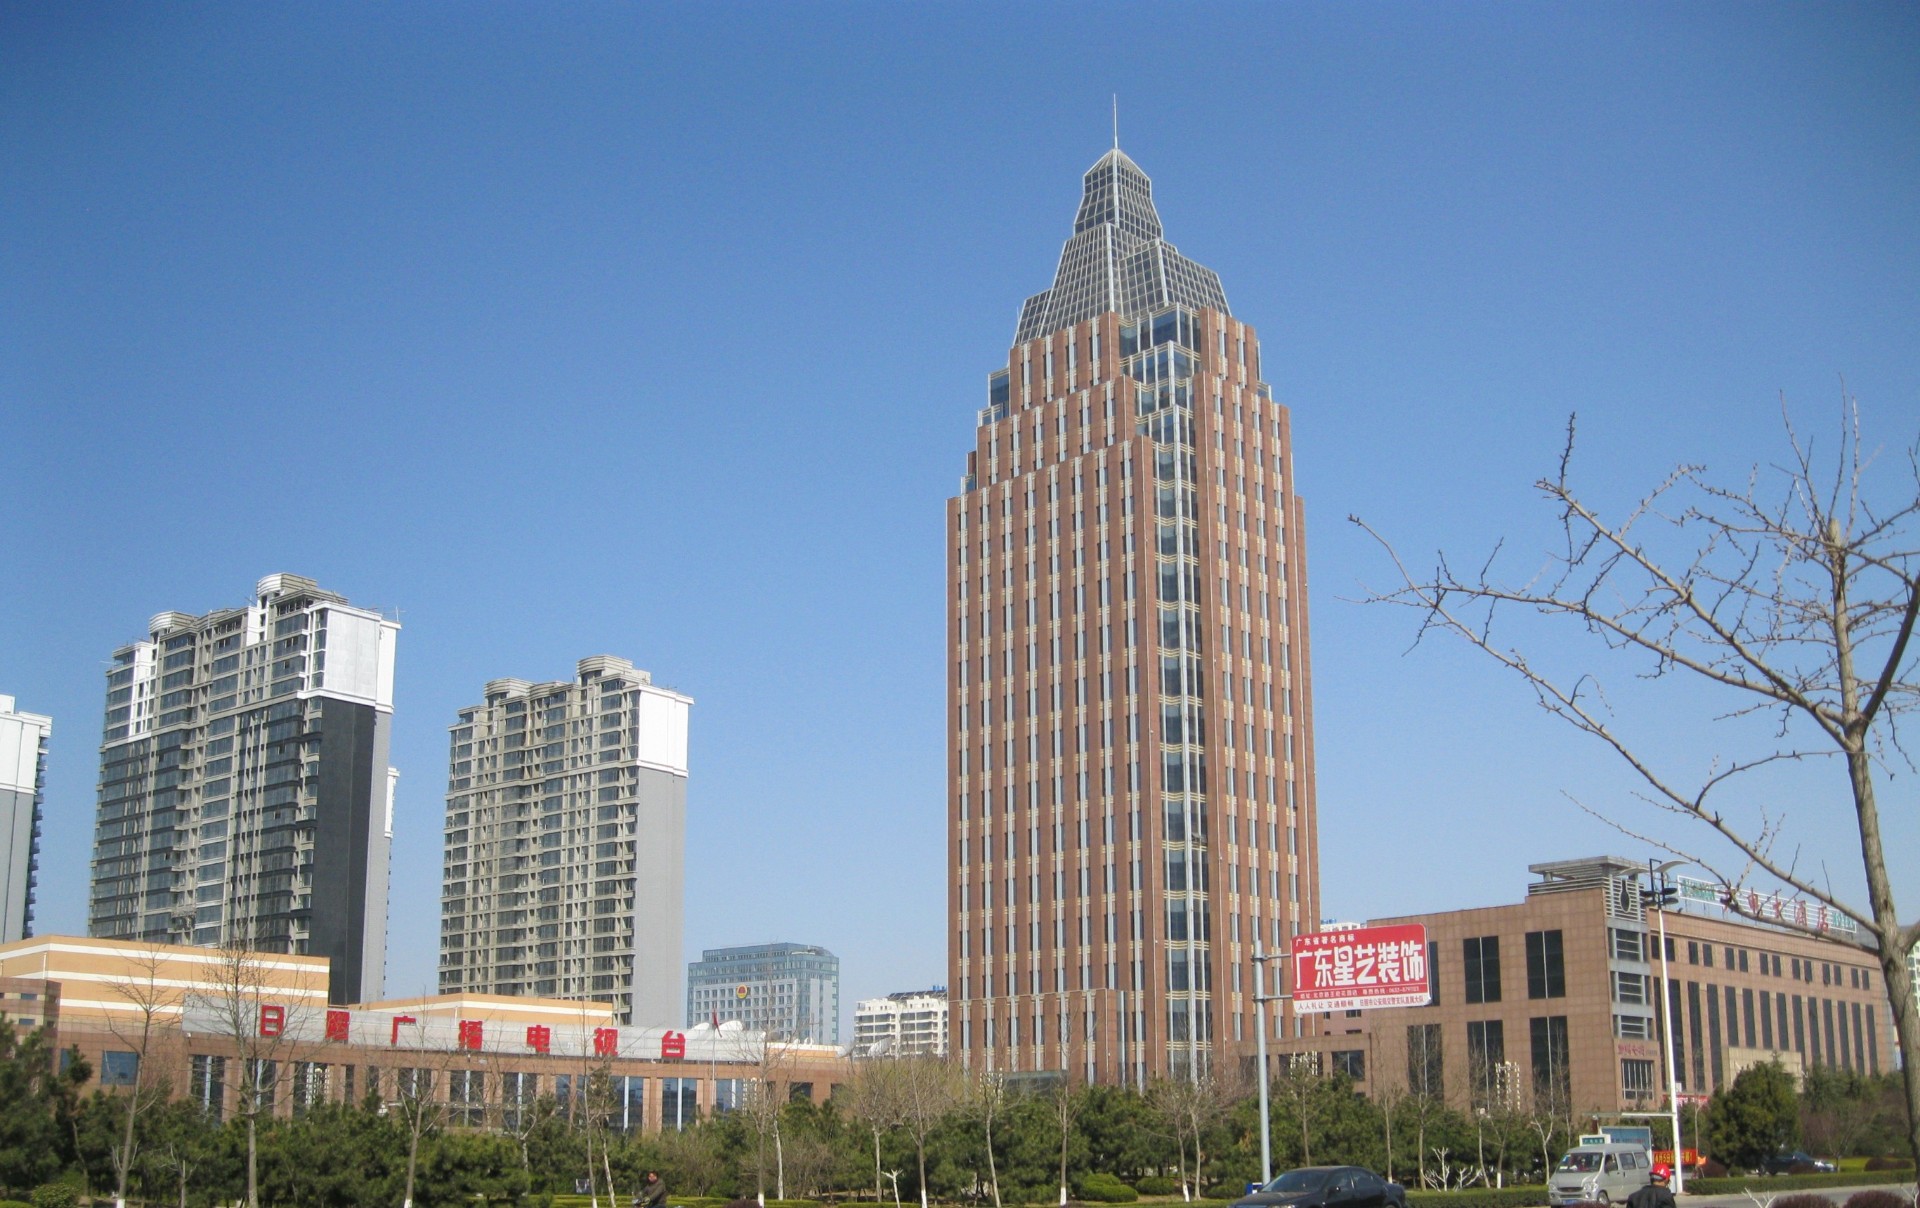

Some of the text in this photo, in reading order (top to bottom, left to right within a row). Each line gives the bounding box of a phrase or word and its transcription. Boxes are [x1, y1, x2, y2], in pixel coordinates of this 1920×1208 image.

[1296, 934, 1355, 947] 广东省著名商标
[1296, 940, 1424, 989] 广东星艺装饰
[260, 1005, 685, 1058] 日照广播电视台
